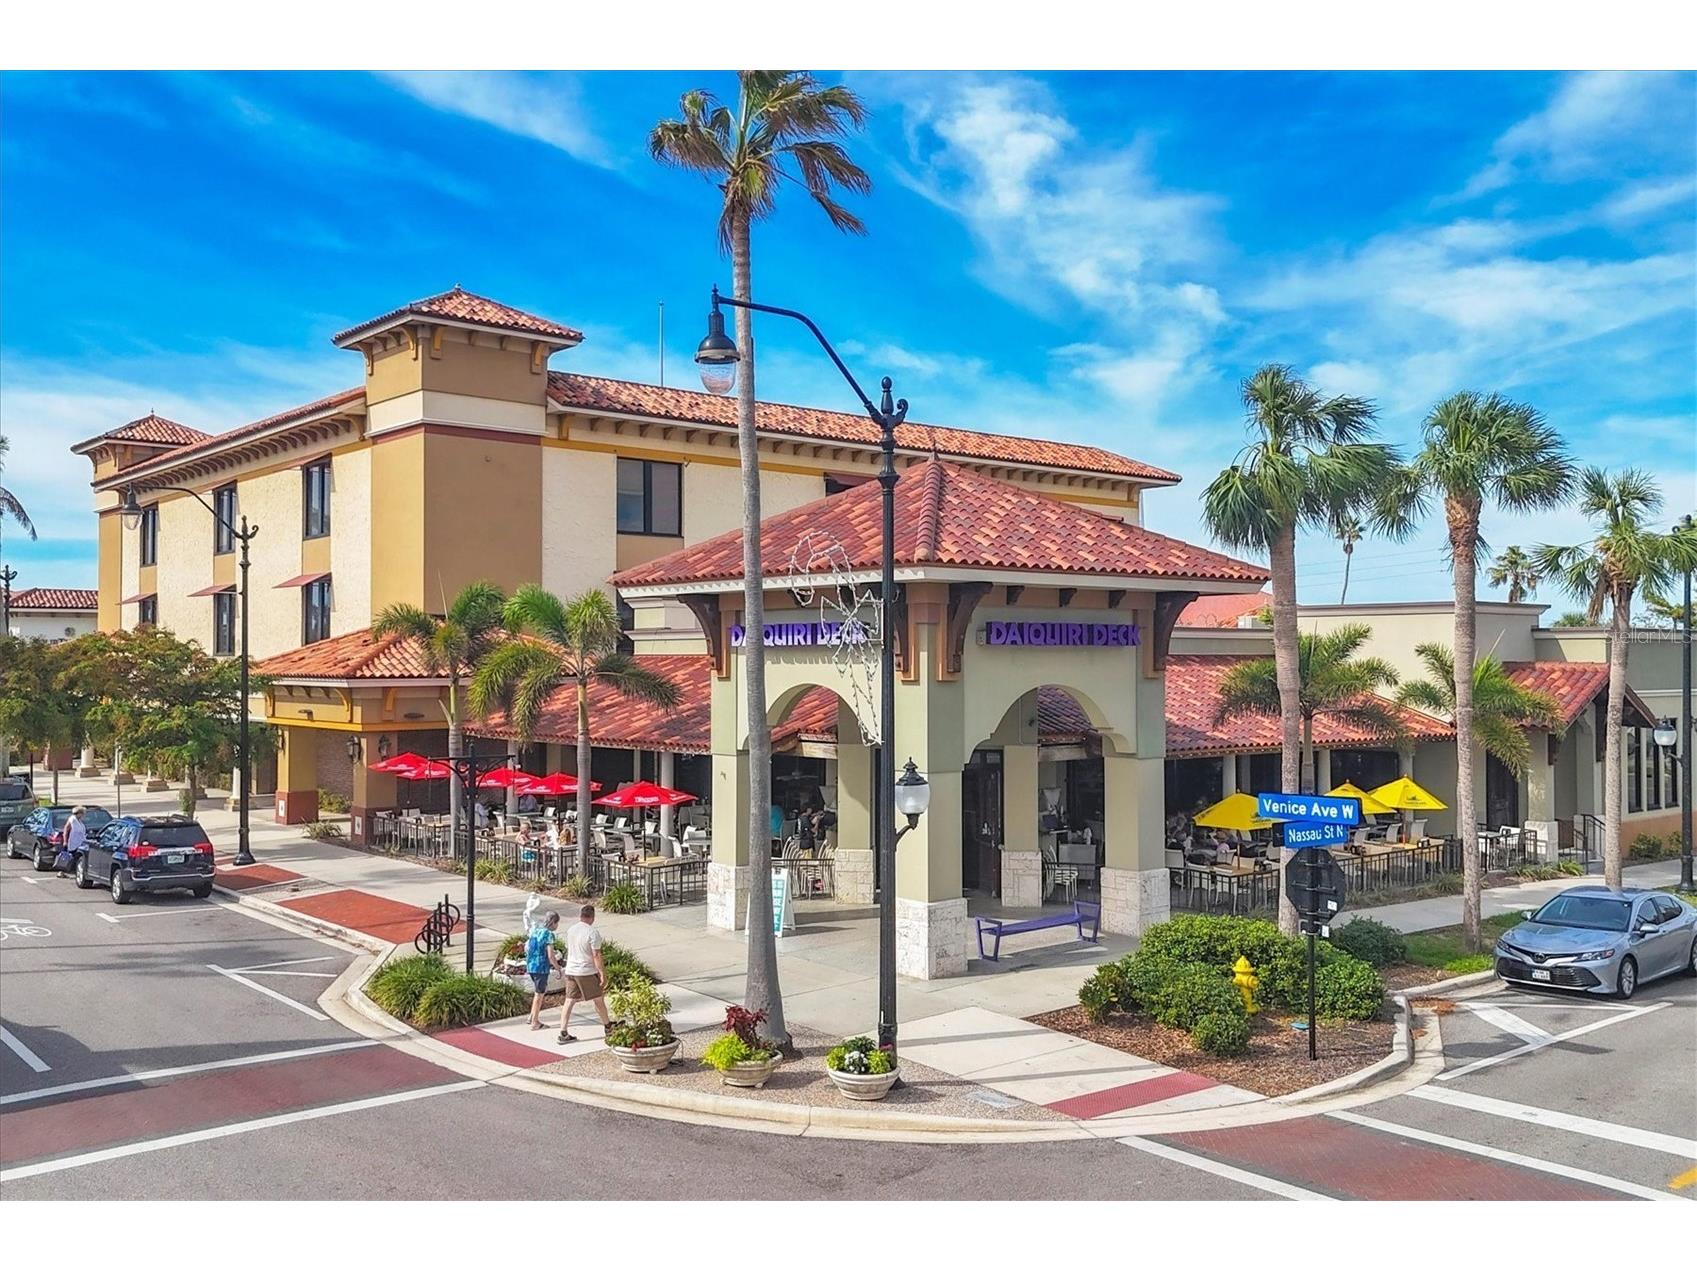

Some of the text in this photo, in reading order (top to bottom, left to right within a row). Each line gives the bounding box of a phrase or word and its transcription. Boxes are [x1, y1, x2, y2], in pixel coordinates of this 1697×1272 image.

[730, 622, 813, 647] DQUIRI
[990, 621, 1142, 646] DAIQUIRI DECK
[1263, 798, 1354, 819] Venice Ave W
[1288, 824, 1344, 843] Nassau St N
